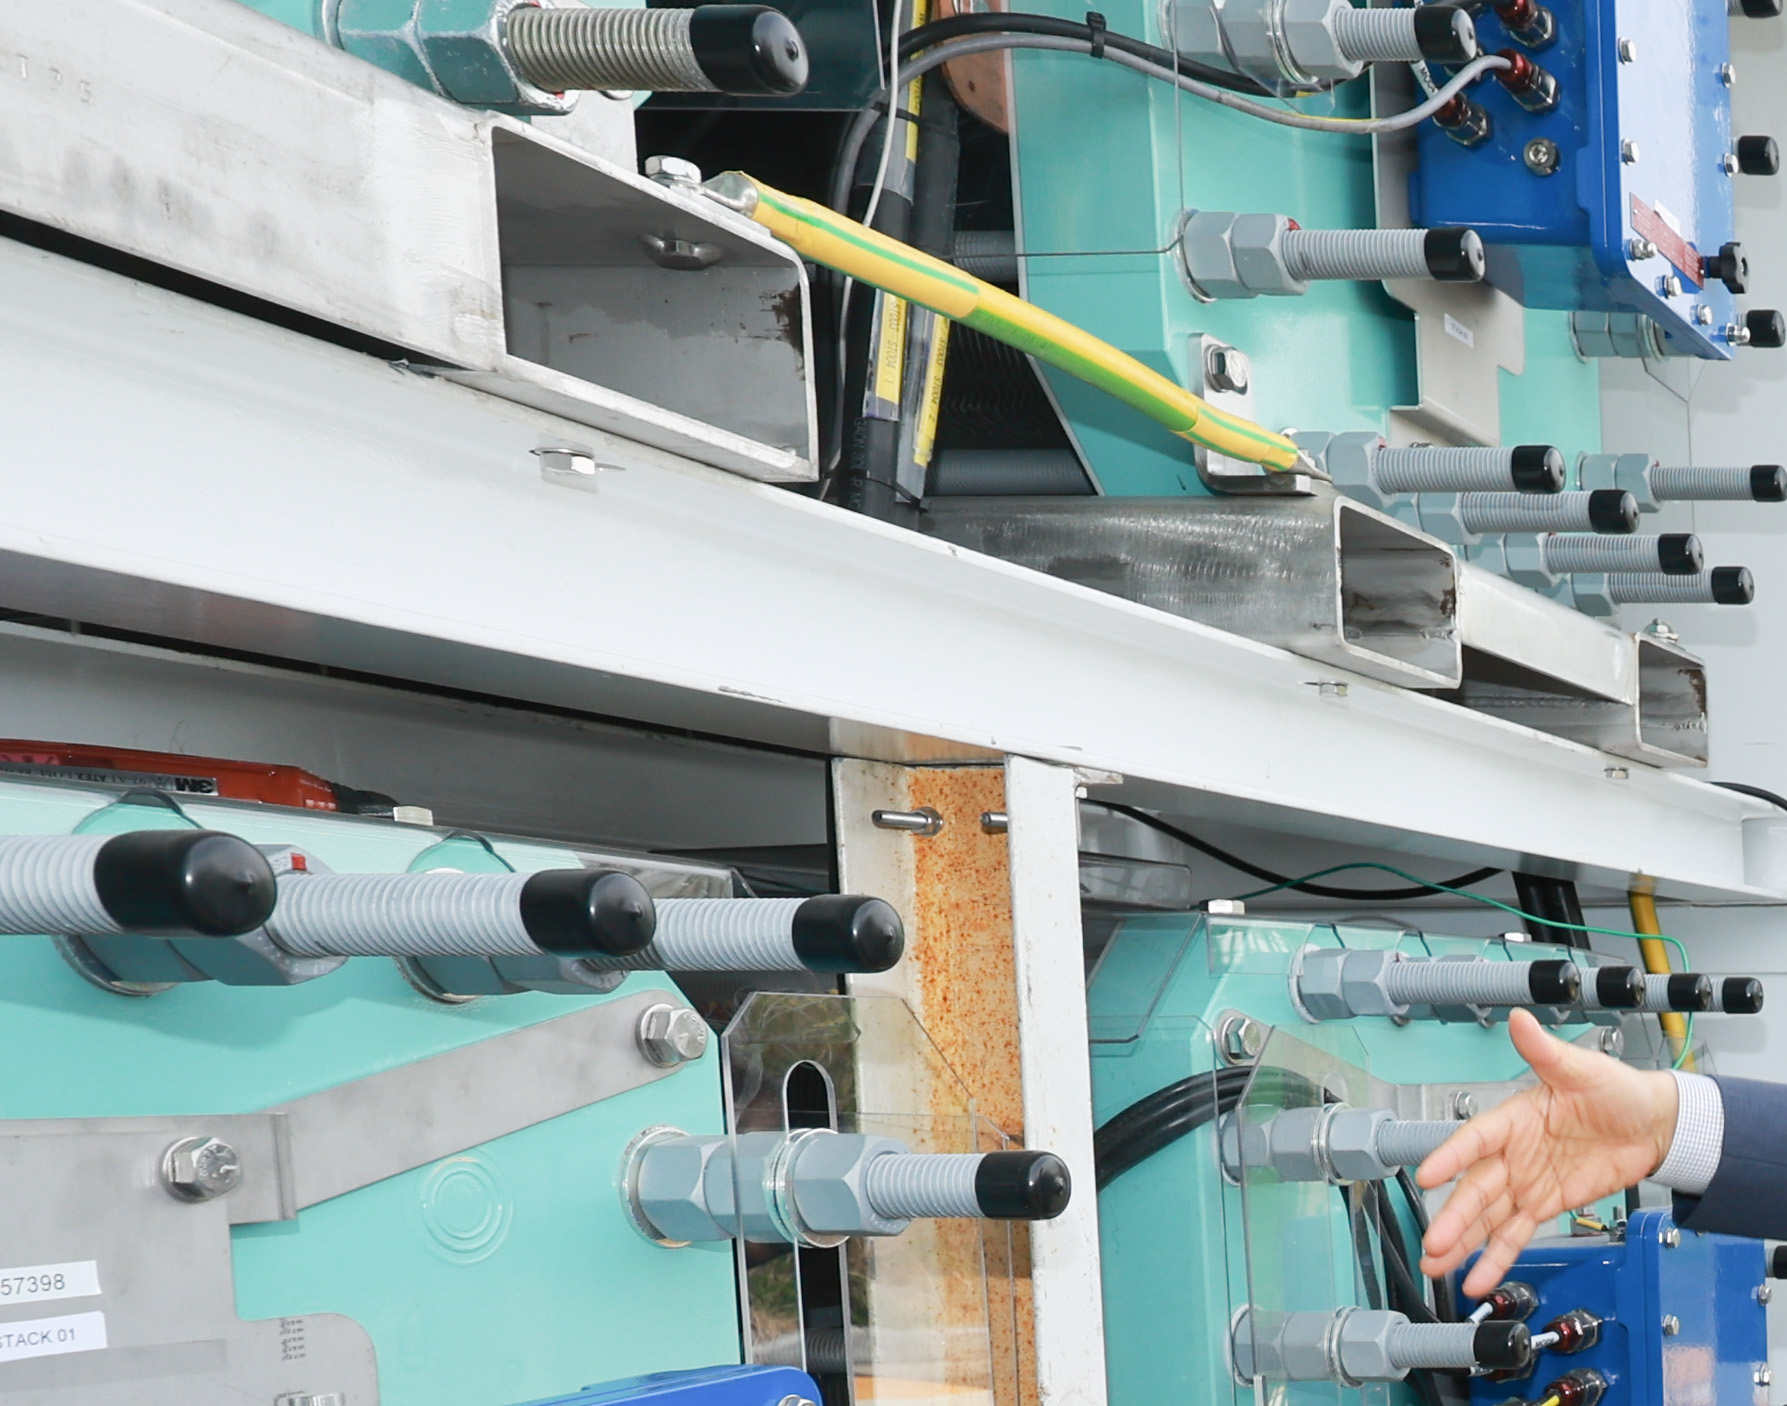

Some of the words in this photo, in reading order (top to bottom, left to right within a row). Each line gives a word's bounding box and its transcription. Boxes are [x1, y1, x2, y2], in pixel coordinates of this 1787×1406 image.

[175, 776, 214, 794] 3M
[0, 1273, 66, 1296] 57398
[57, 1328, 75, 1342] 01
